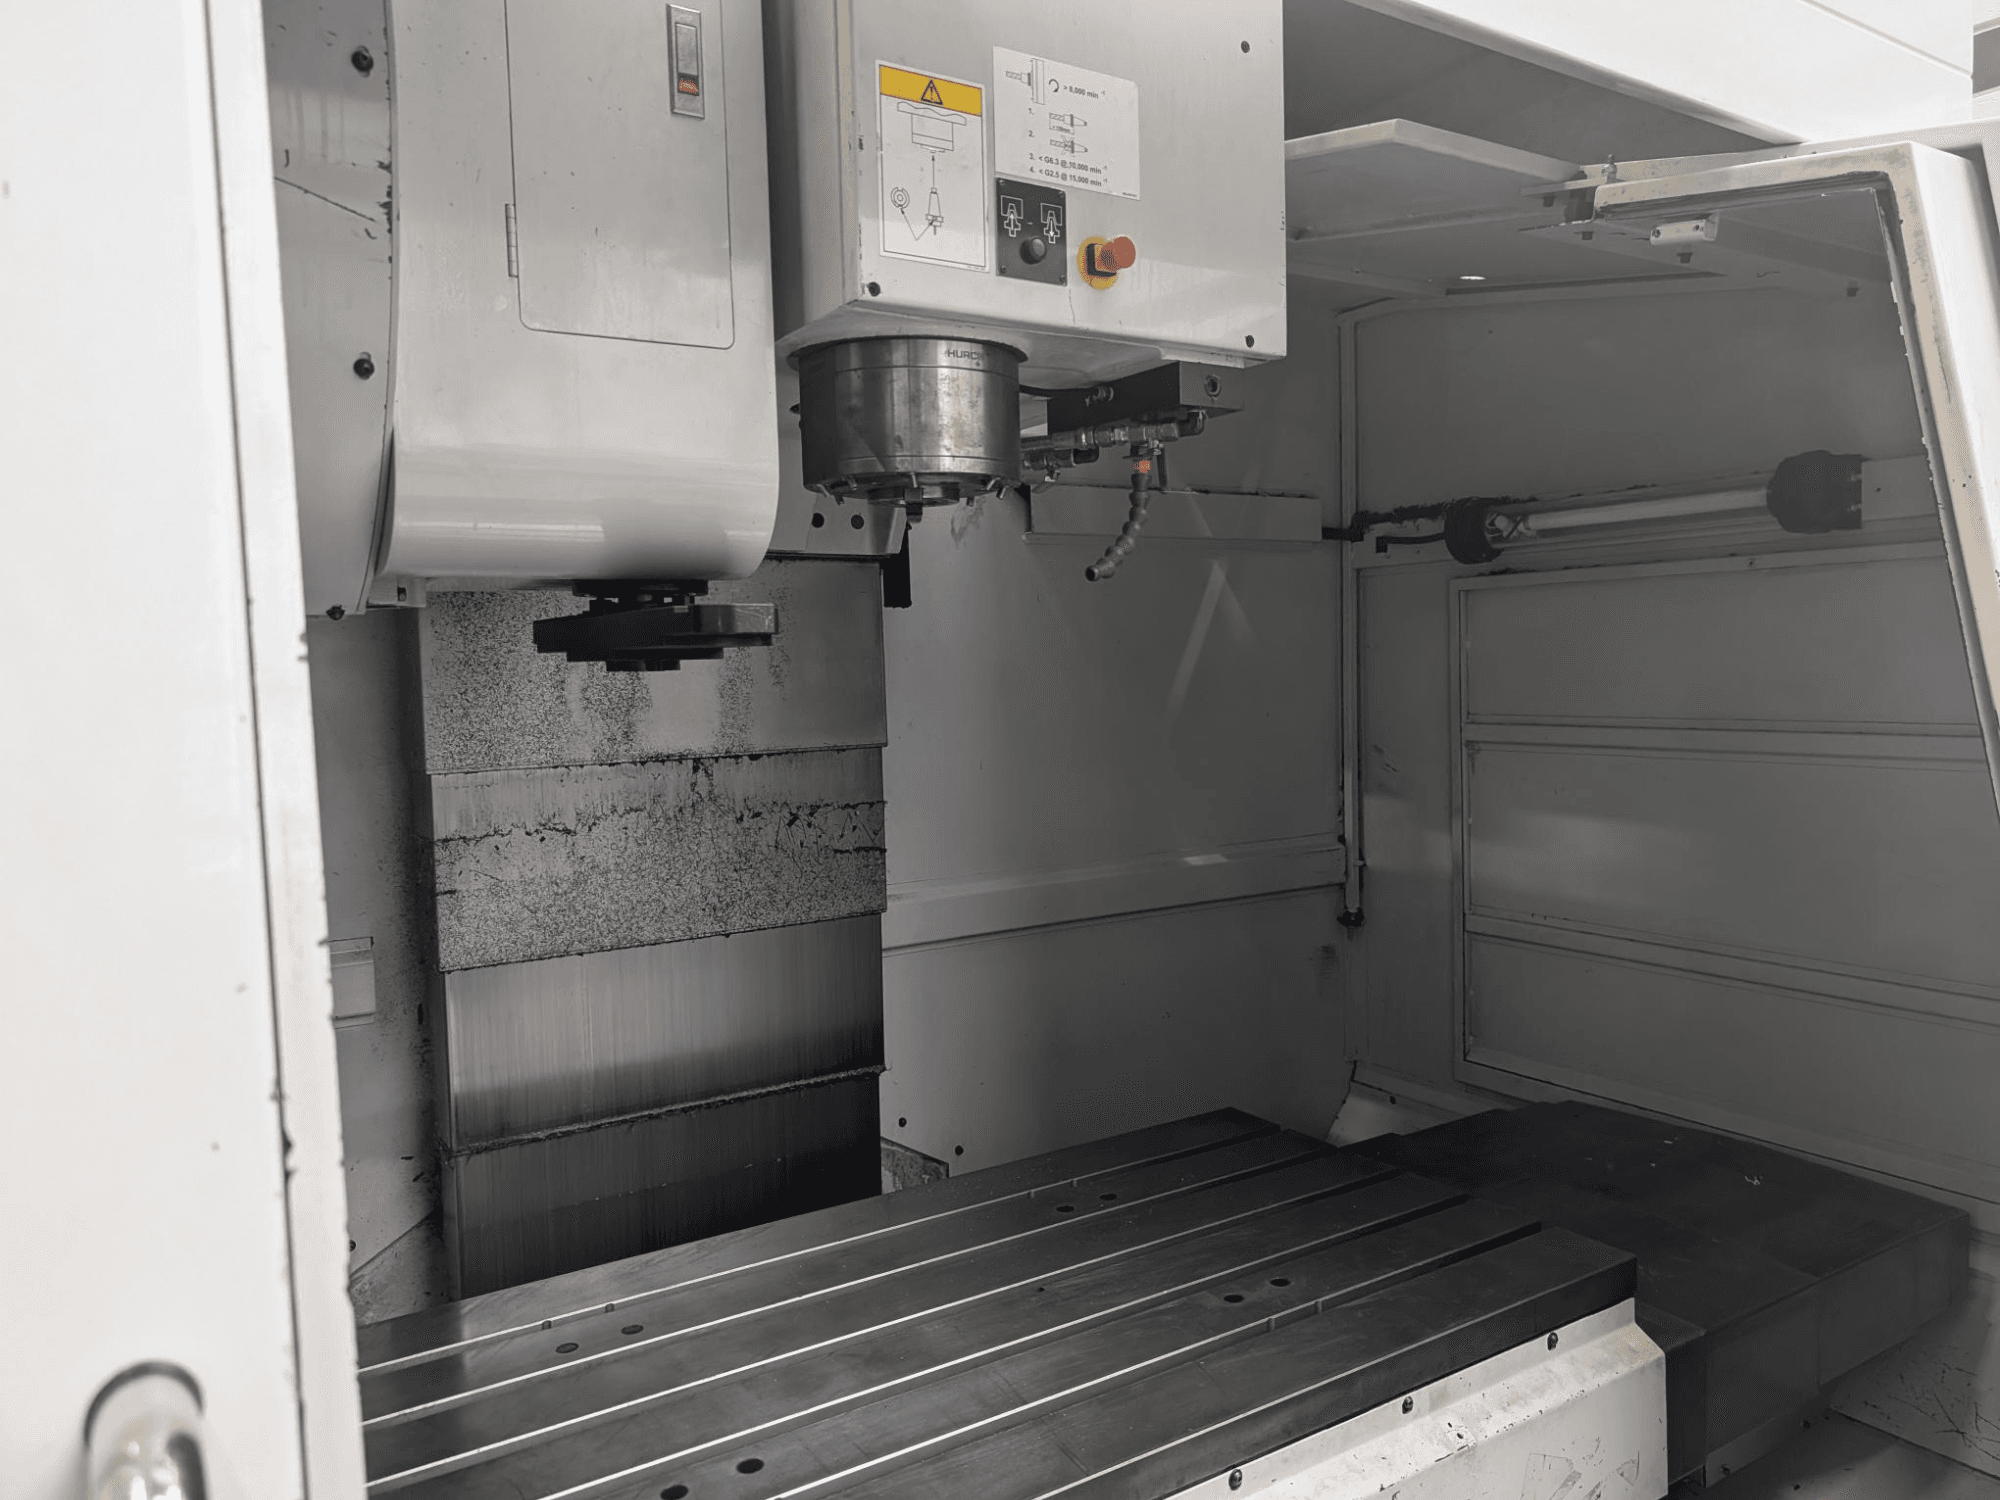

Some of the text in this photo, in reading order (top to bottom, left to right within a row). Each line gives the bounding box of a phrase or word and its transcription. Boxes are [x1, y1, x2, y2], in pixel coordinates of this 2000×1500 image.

[1087, 91, 1098, 99] min
[1028, 107, 1034, 115] 1.
[1029, 152, 1035, 161] 3.
[1044, 156, 1059, 165] G6.3
[1060, 159, 1067, 168] @
[1090, 166, 1102, 174] min
[1044, 169, 1059, 178] G2.5
[1061, 172, 1067, 181] @
[1069, 174, 1088, 184] 15,000
[1090, 179, 1102, 187] min
